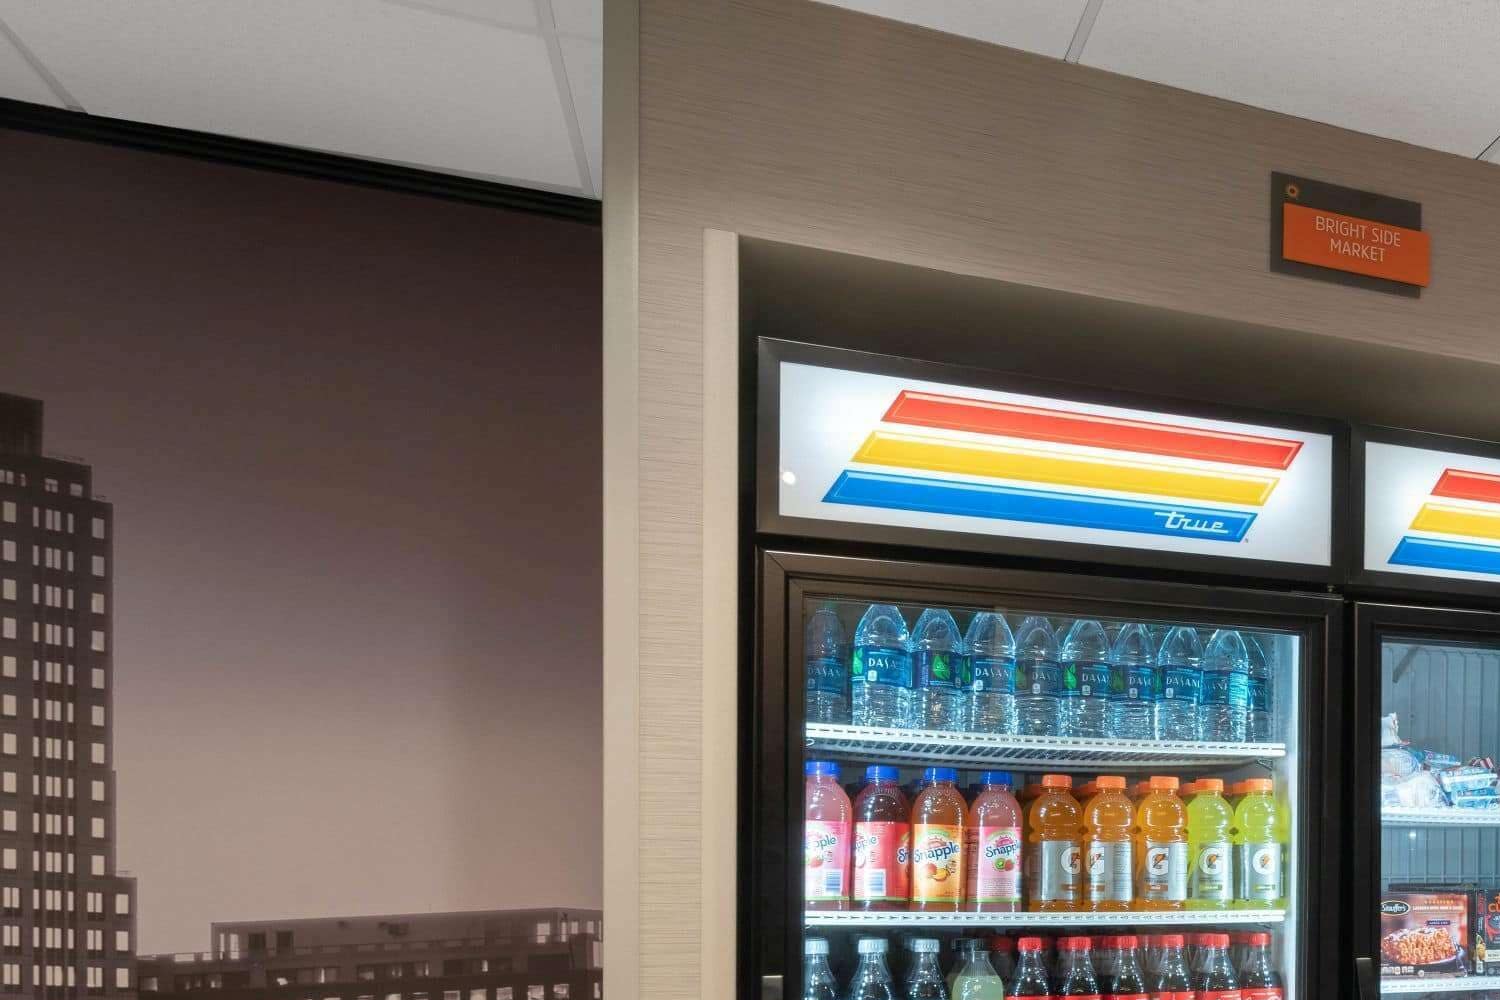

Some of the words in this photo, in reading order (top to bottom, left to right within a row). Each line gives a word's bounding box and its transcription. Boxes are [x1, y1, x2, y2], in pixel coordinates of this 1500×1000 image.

[1315, 216, 1367, 240] BRIGHT
[1372, 227, 1401, 247] SIDE
[1330, 239, 1385, 262] MARKET
[1154, 511, 1229, 534] true
[914, 842, 960, 863] Snapple
